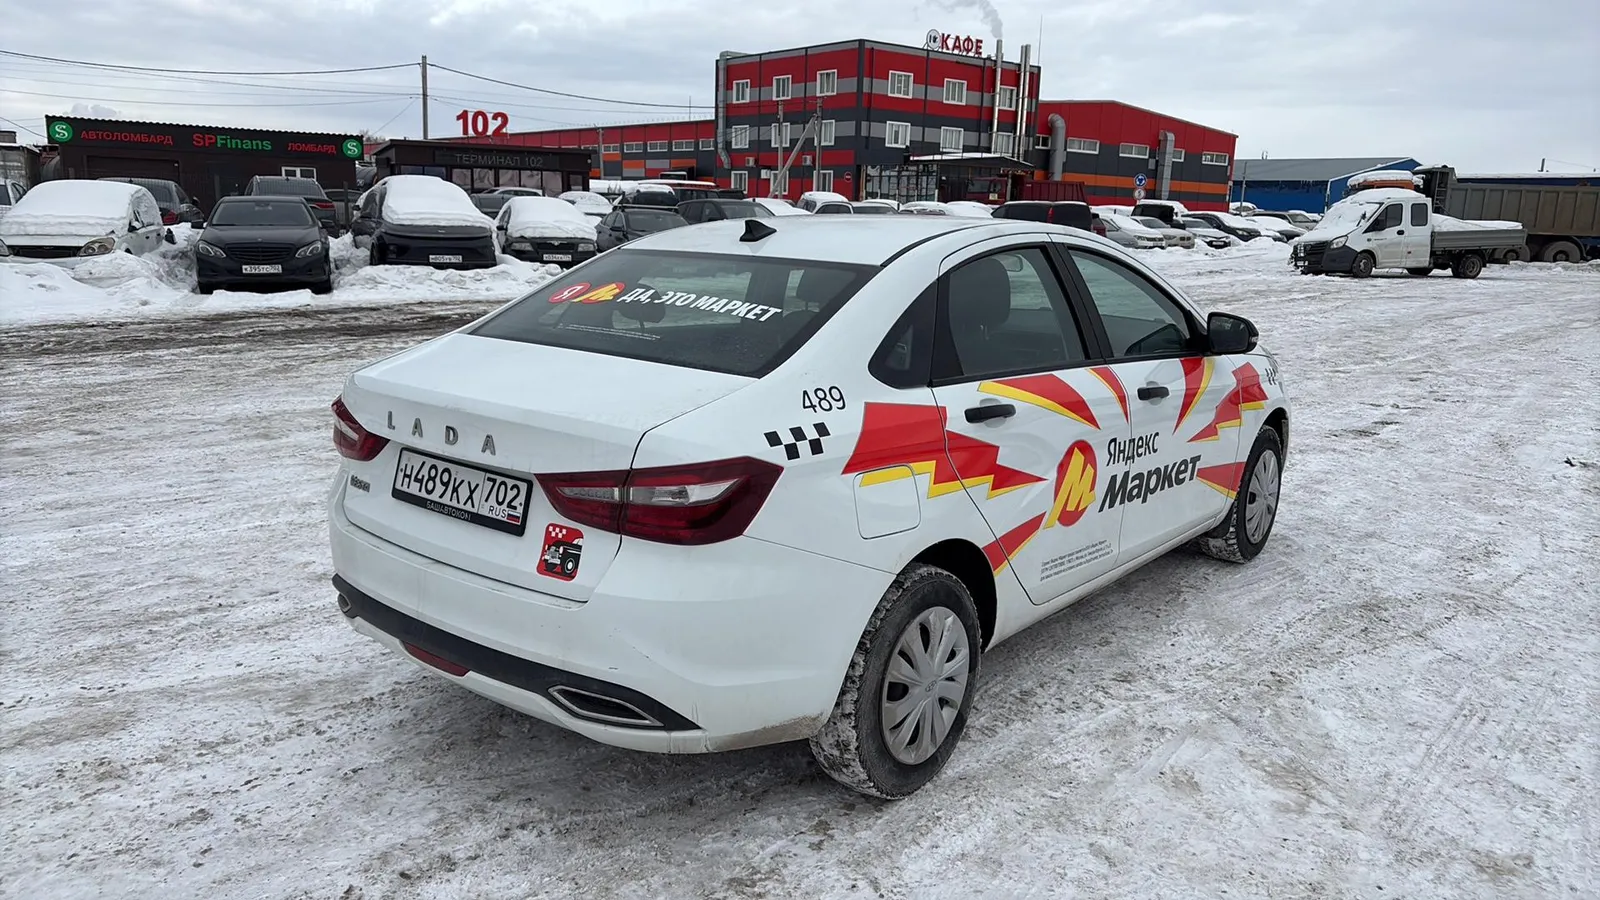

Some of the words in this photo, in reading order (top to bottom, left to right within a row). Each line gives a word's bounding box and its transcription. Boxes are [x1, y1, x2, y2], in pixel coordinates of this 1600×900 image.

[941, 33, 983, 55] КАФЕ
[456, 109, 509, 137] 102
[80, 130, 174, 145] АВТОЛОМБАРД
[192, 133, 272, 151] SPFinans
[287, 142, 337, 155] ЛОМБАРД
[455, 153, 521, 166] ТЕРМИНАЛ
[525, 157, 543, 167] 102
[616, 288, 654, 304] ДА,
[653, 291, 696, 305] ЭТО
[690, 296, 782, 323] МАРКЕТ
[803, 386, 846, 413] 489
[387, 411, 496, 456] LADA
[1106, 432, 1160, 467] Яндекс
[400, 460, 480, 509] Н489КХ
[484, 477, 521, 510] 702
[1098, 455, 1202, 513] Маркет
[488, 505, 507, 519] RUS
